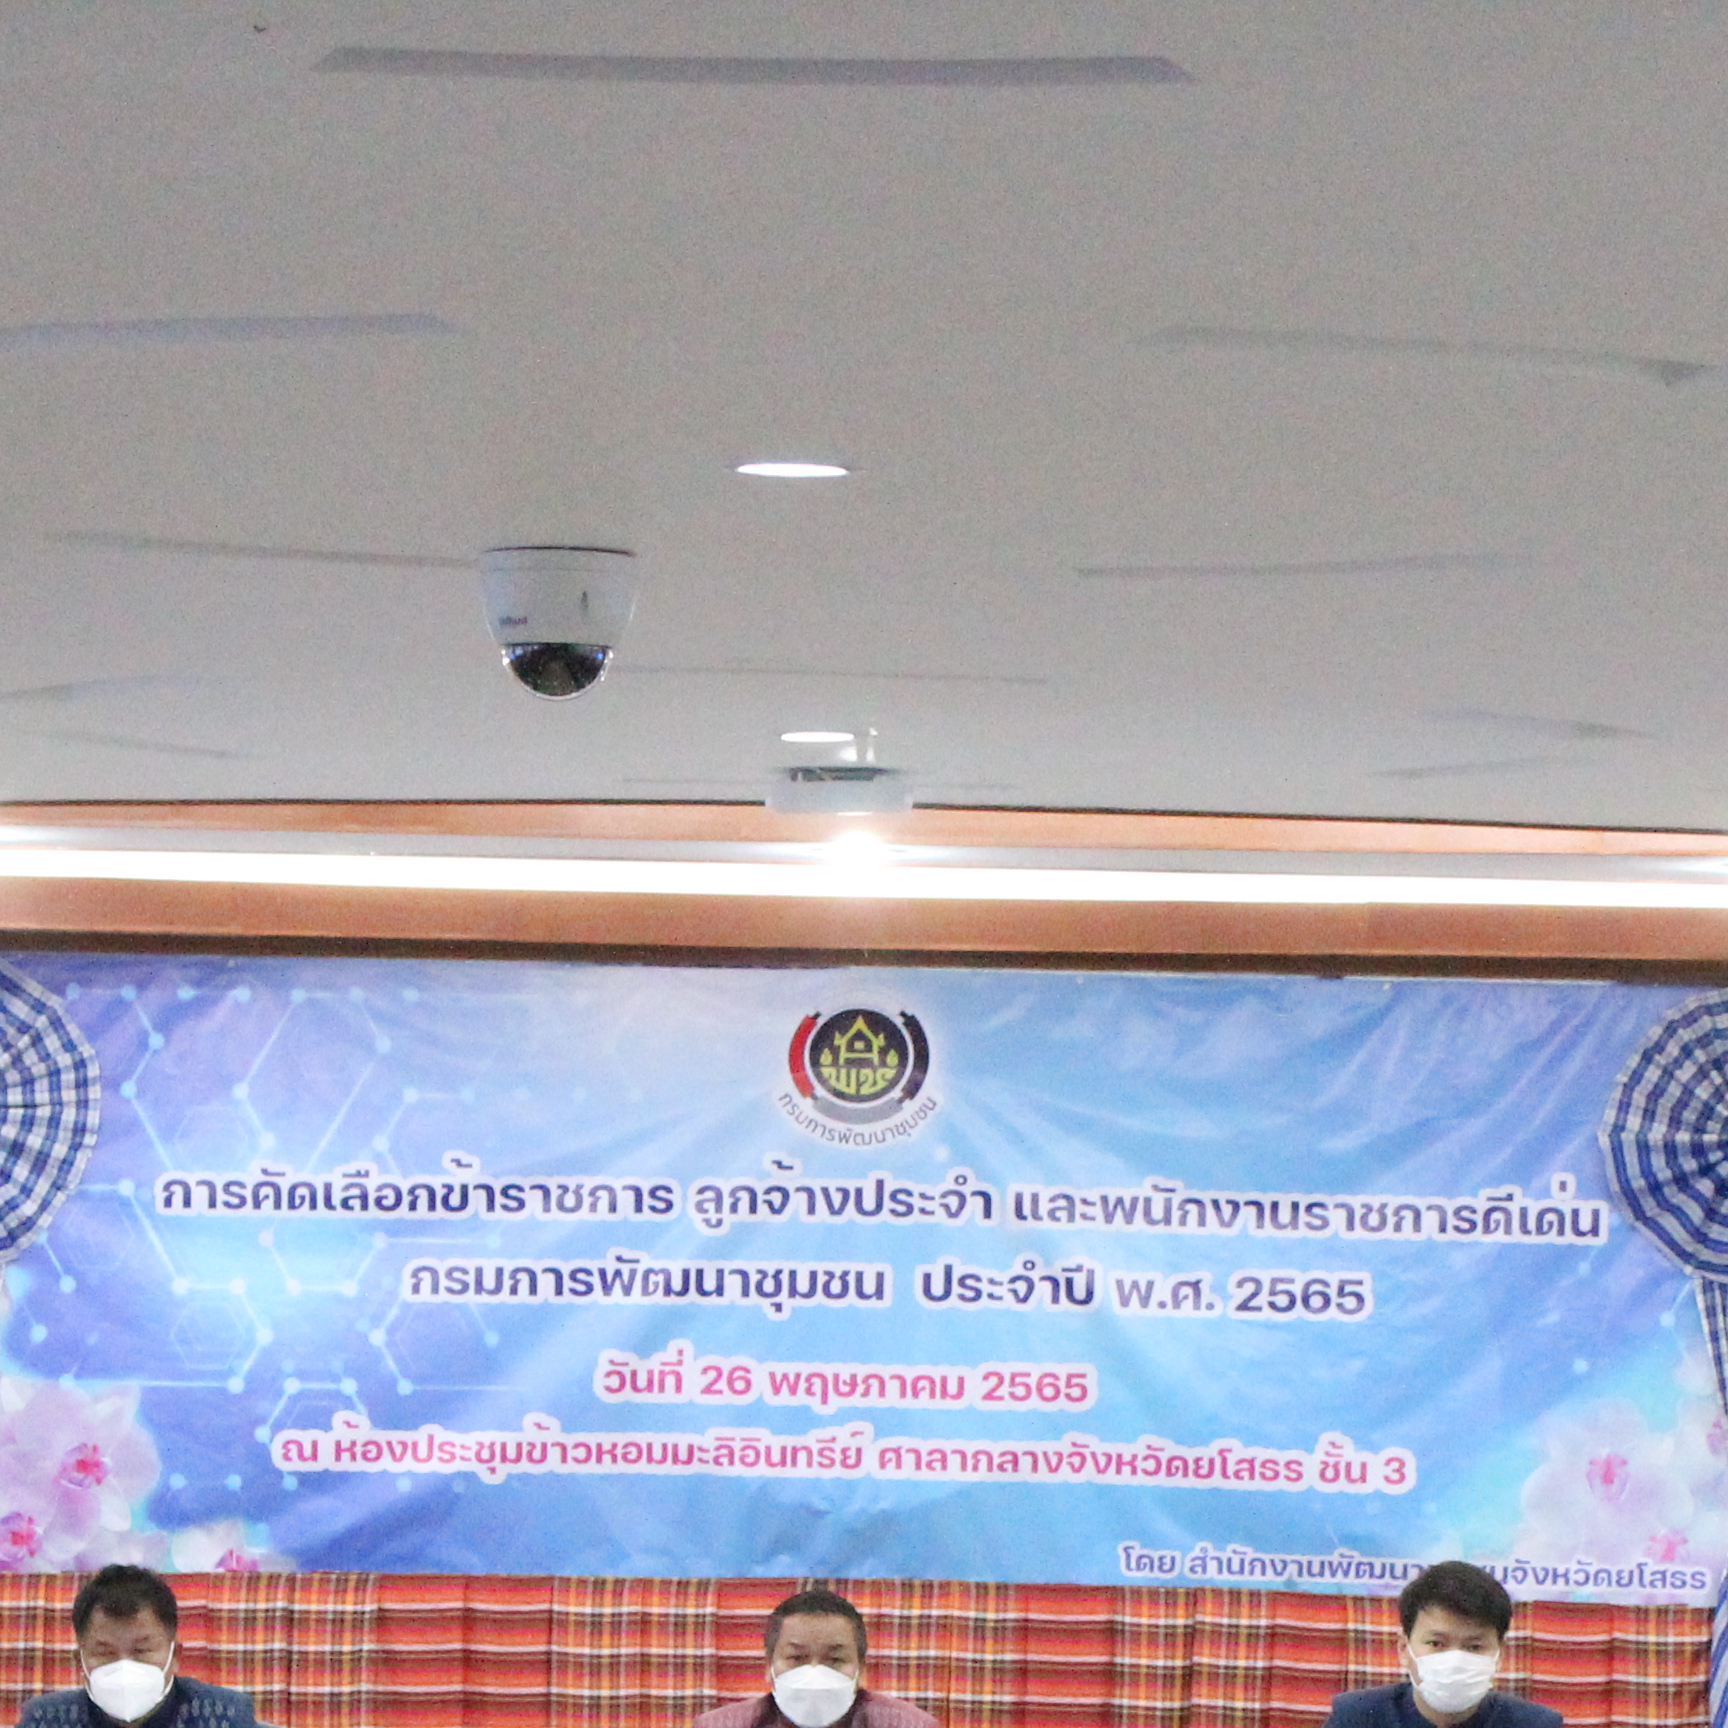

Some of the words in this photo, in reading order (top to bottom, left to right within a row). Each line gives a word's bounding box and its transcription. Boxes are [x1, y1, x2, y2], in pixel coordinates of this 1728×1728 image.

[778, 1092, 938, 1146] กรมการพัฒนาชุมชน
[161, 1157, 675, 1215] การคัดเลือกข้าราชการ
[693, 1159, 994, 1229] ลูกจ้างประจำ
[1013, 1180, 1603, 1239] และพนักงานราชการดีเด่น
[409, 1254, 886, 1314] กรมการพัฒนาชุมชน
[921, 1260, 1095, 1308] ประจำปี
[1114, 1276, 1216, 1312] พ.ศ.
[1233, 1275, 1367, 1315] 2565
[602, 1348, 684, 1396] วันที่
[699, 1364, 753, 1397] 26
[768, 1367, 966, 1406] พฤษภาคม
[980, 1370, 1090, 1403] 2565
[280, 1437, 319, 1464] ณ
[333, 1420, 864, 1475] ห้องประชุมข้าวหอมมะลิอินทรีย์
[877, 1441, 1305, 1483] ศาลากลางจังหวัดยโสธร
[1317, 1440, 1368, 1485] ชั้น
[1381, 1456, 1407, 1486] 3
[1122, 1546, 1176, 1574] โดย
